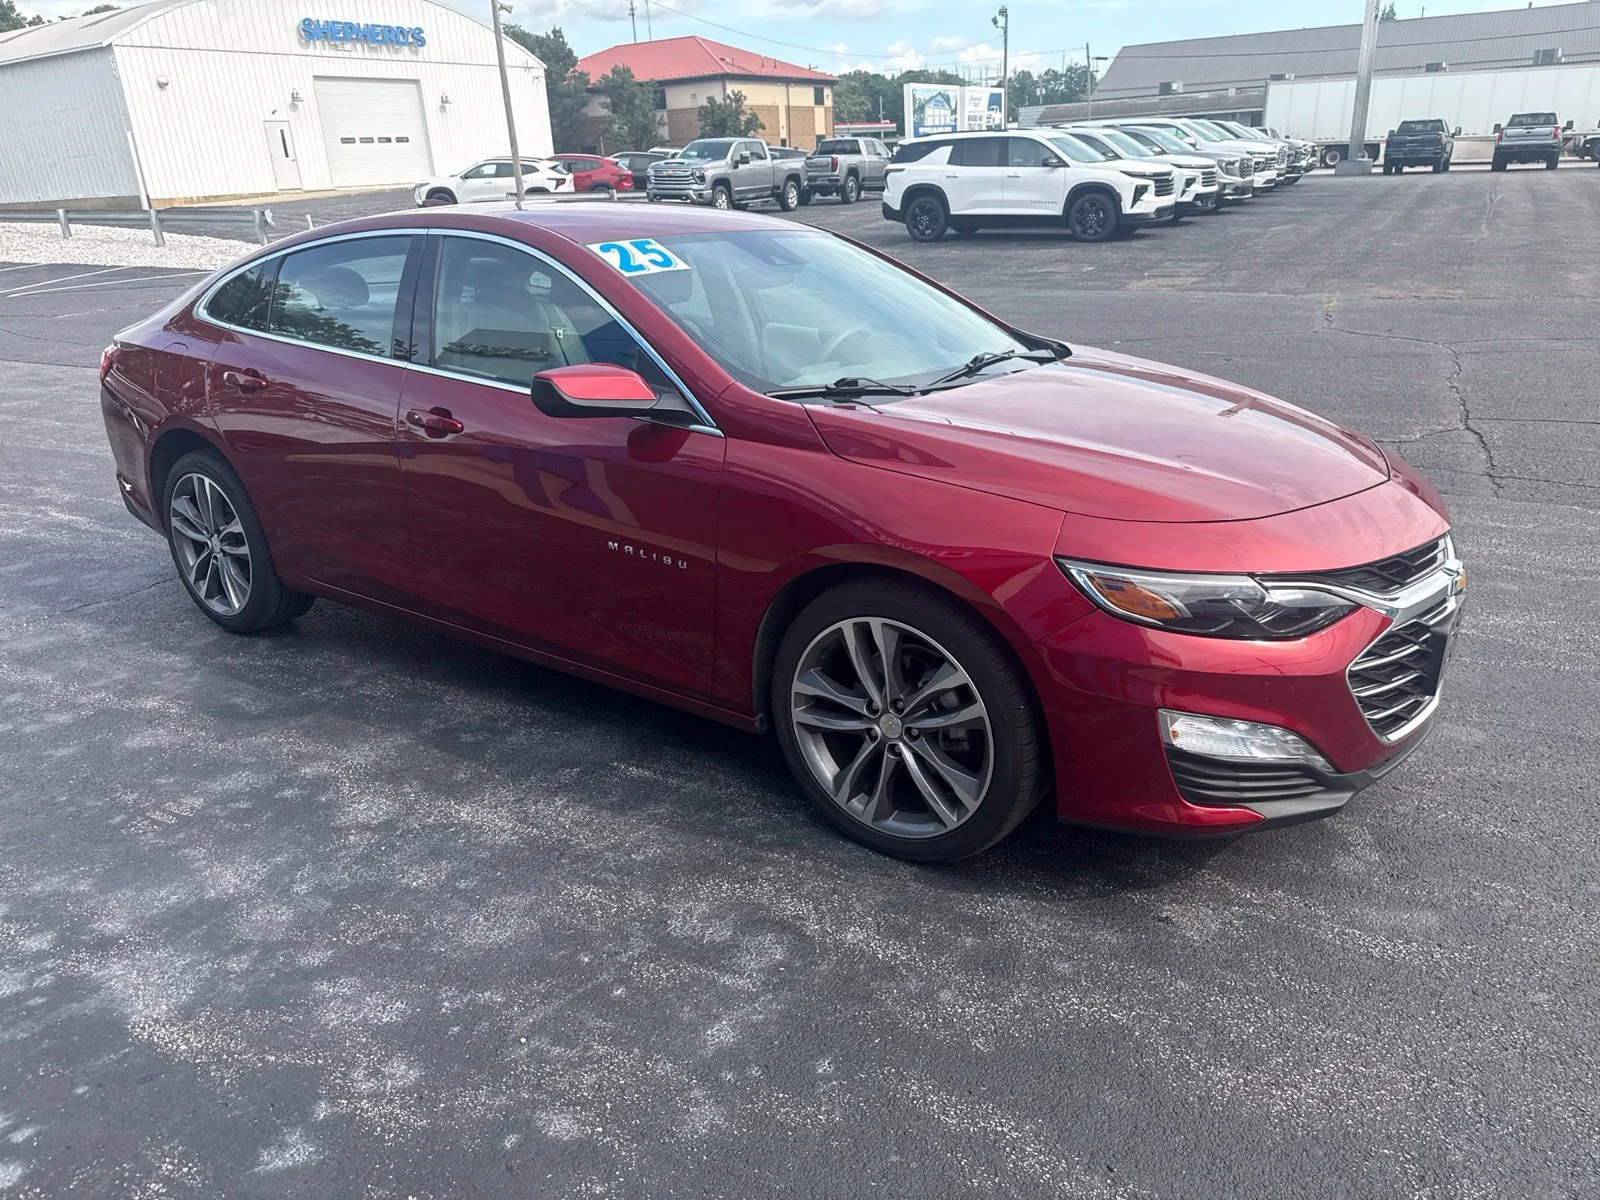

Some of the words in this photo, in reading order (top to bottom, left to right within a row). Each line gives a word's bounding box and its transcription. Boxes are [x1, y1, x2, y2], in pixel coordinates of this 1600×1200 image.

[301, 17, 427, 48] SHEPHERD'S
[599, 239, 674, 273] 25
[607, 541, 687, 569] MALIBU
